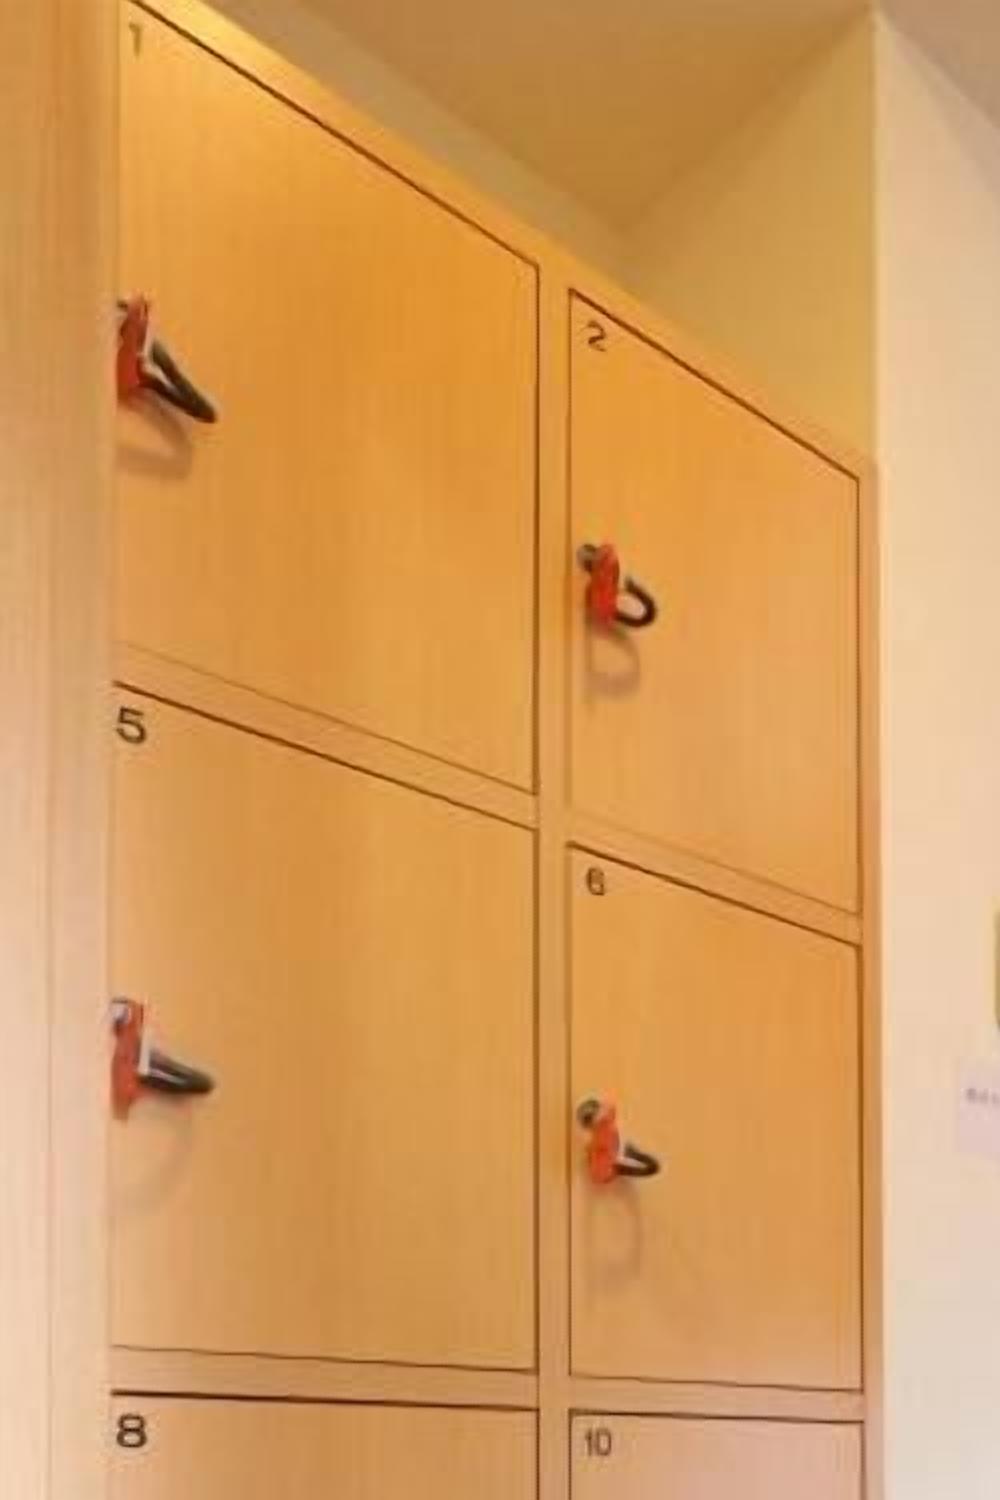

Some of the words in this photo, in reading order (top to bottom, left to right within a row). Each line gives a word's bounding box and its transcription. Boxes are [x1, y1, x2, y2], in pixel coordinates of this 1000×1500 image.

[128, 22, 143, 58] 1
[586, 320, 608, 352] 2
[117, 706, 147, 744] 5
[586, 866, 605, 897] 6
[116, 1413, 148, 1448] 8
[586, 1428, 613, 1458] 10
